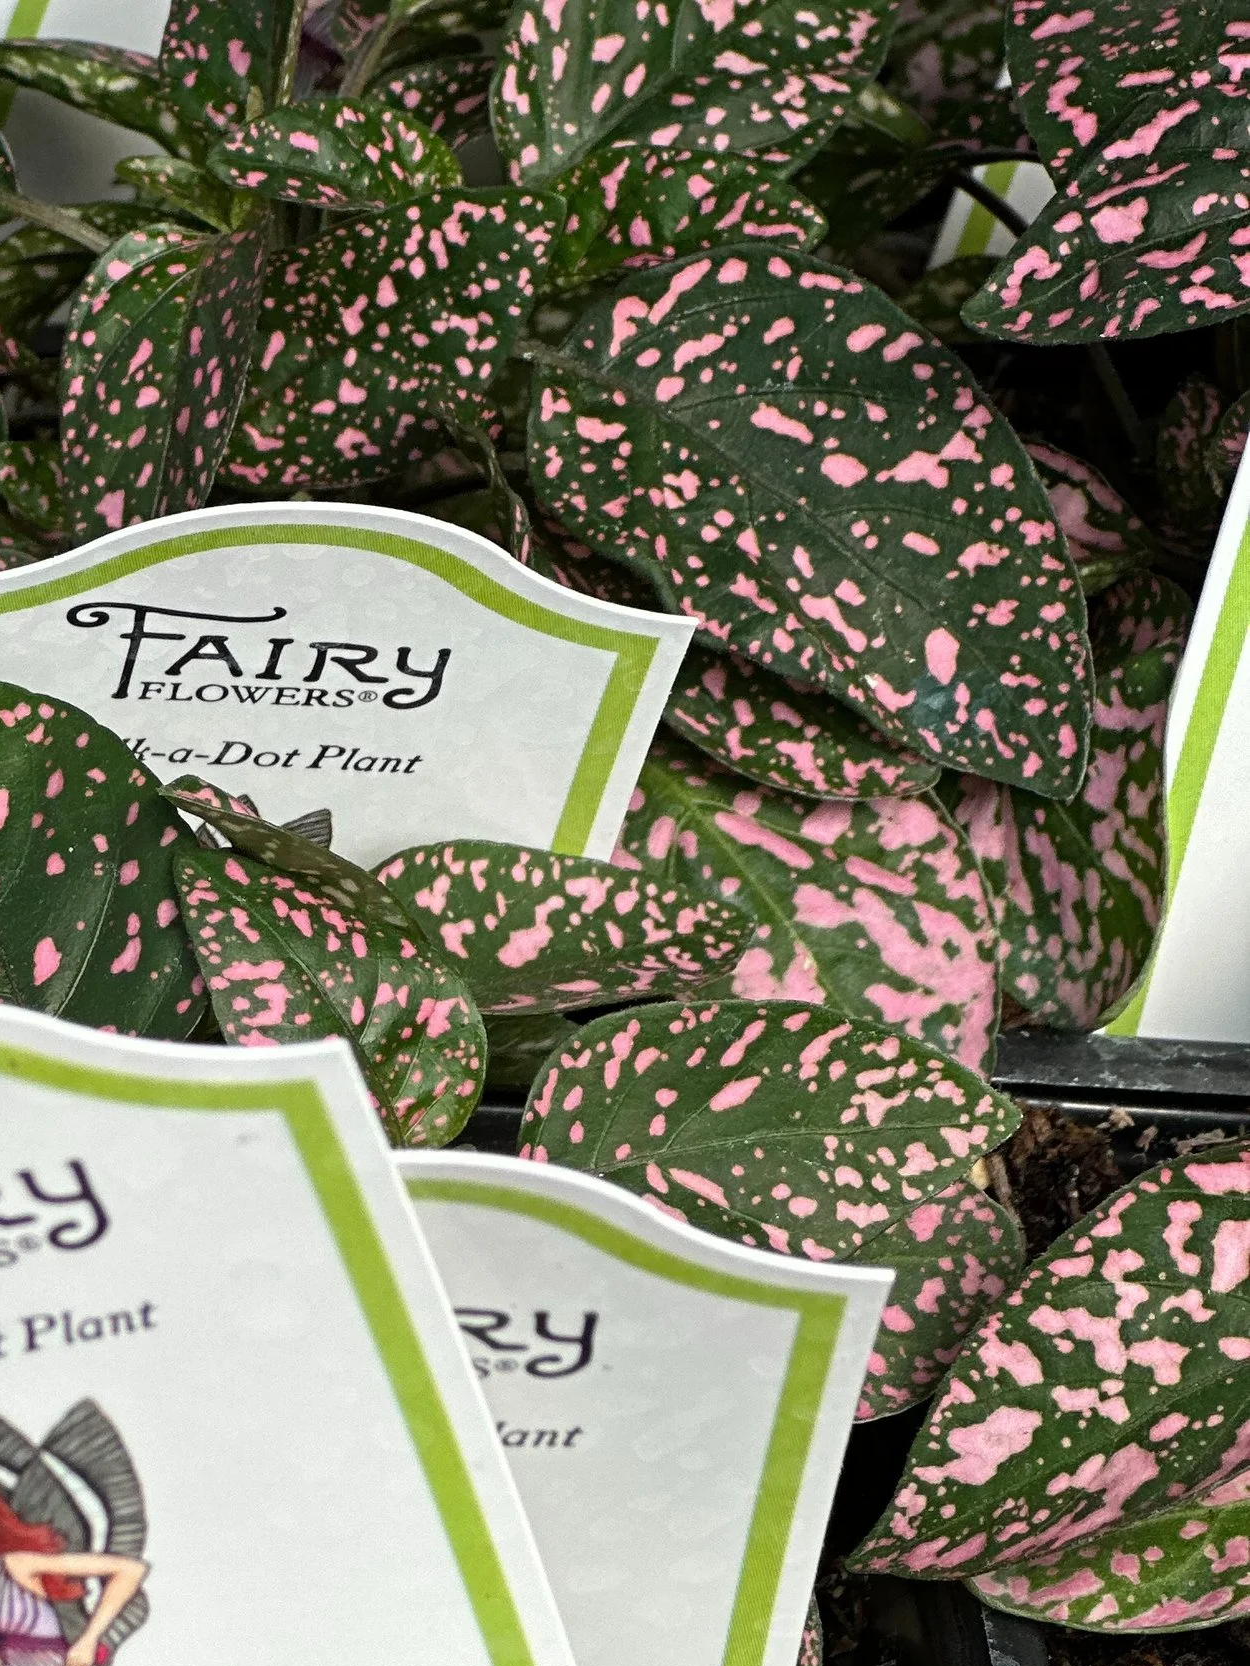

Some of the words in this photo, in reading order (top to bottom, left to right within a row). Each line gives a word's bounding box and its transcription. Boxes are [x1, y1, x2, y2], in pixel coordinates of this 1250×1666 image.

[306, 744, 424, 774] Plant
[21, 1300, 158, 1353] Plant
[497, 1420, 583, 1449] ant
